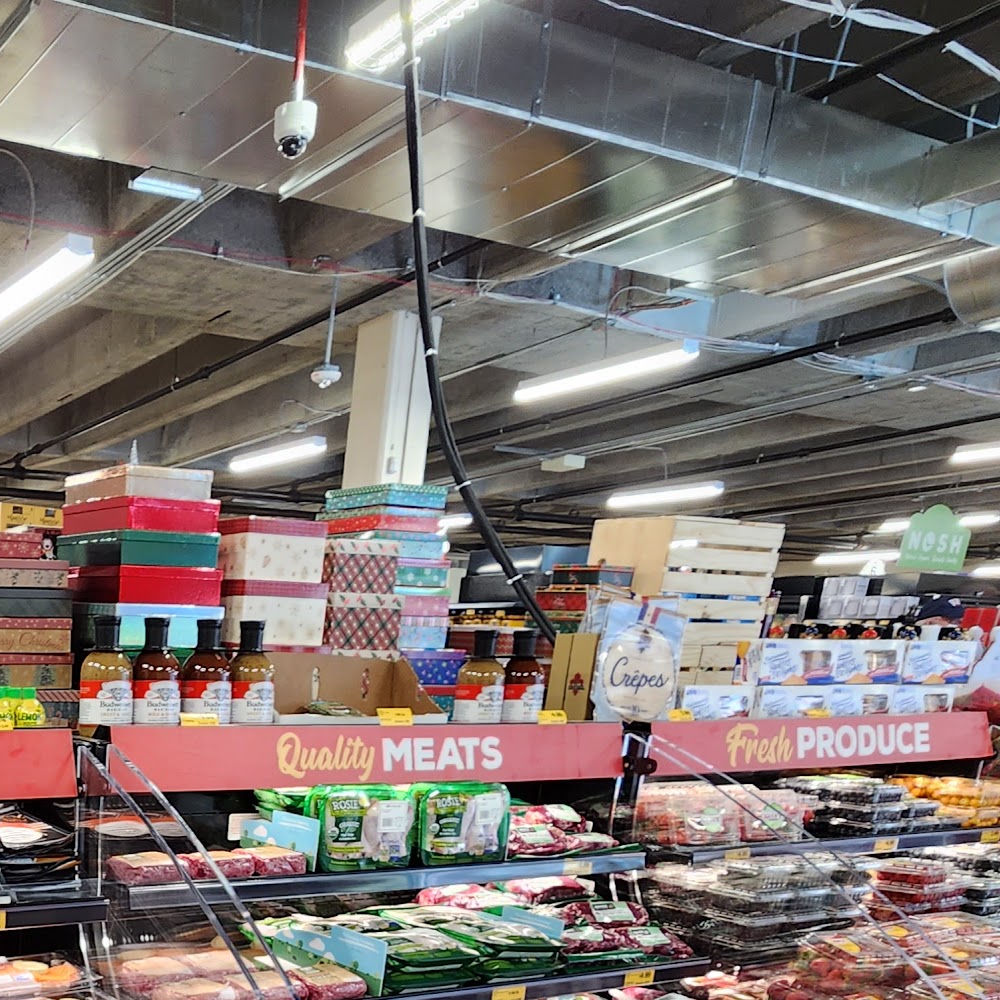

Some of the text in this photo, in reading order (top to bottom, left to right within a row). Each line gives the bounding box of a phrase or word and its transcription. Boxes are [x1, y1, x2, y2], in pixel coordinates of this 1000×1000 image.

[908, 531, 964, 554] NOSH
[610, 656, 670, 695] Crêpes
[276, 731, 504, 782] Quality MEATS
[725, 722, 931, 768] Fresh PRODUCE
[331, 799, 360, 811] ROSIE
